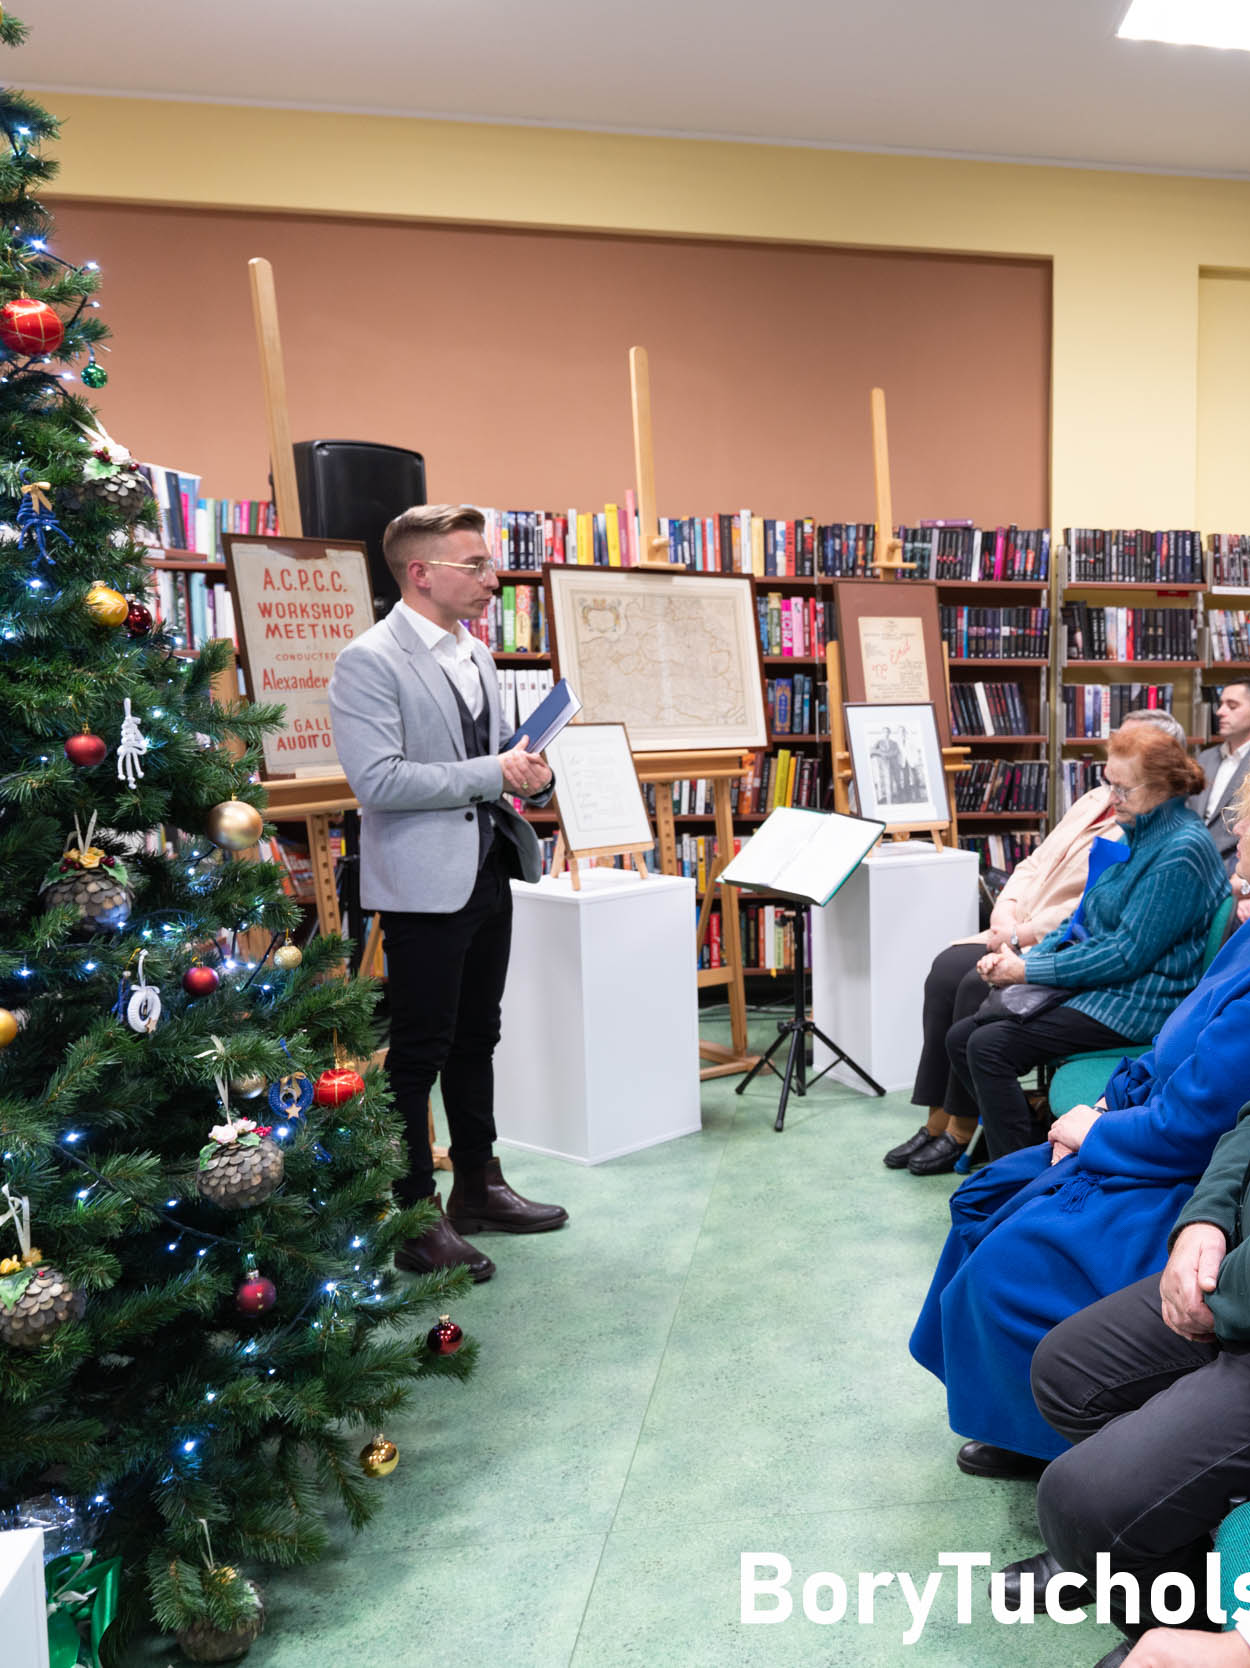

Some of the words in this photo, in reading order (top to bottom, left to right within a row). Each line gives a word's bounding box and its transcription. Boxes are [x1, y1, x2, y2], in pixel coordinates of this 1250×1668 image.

[263, 567, 348, 593] A.C.P.C.C.
[257, 601, 355, 621] WORKSHOP
[264, 623, 355, 641] MEETING
[263, 668, 329, 691] Alexander
